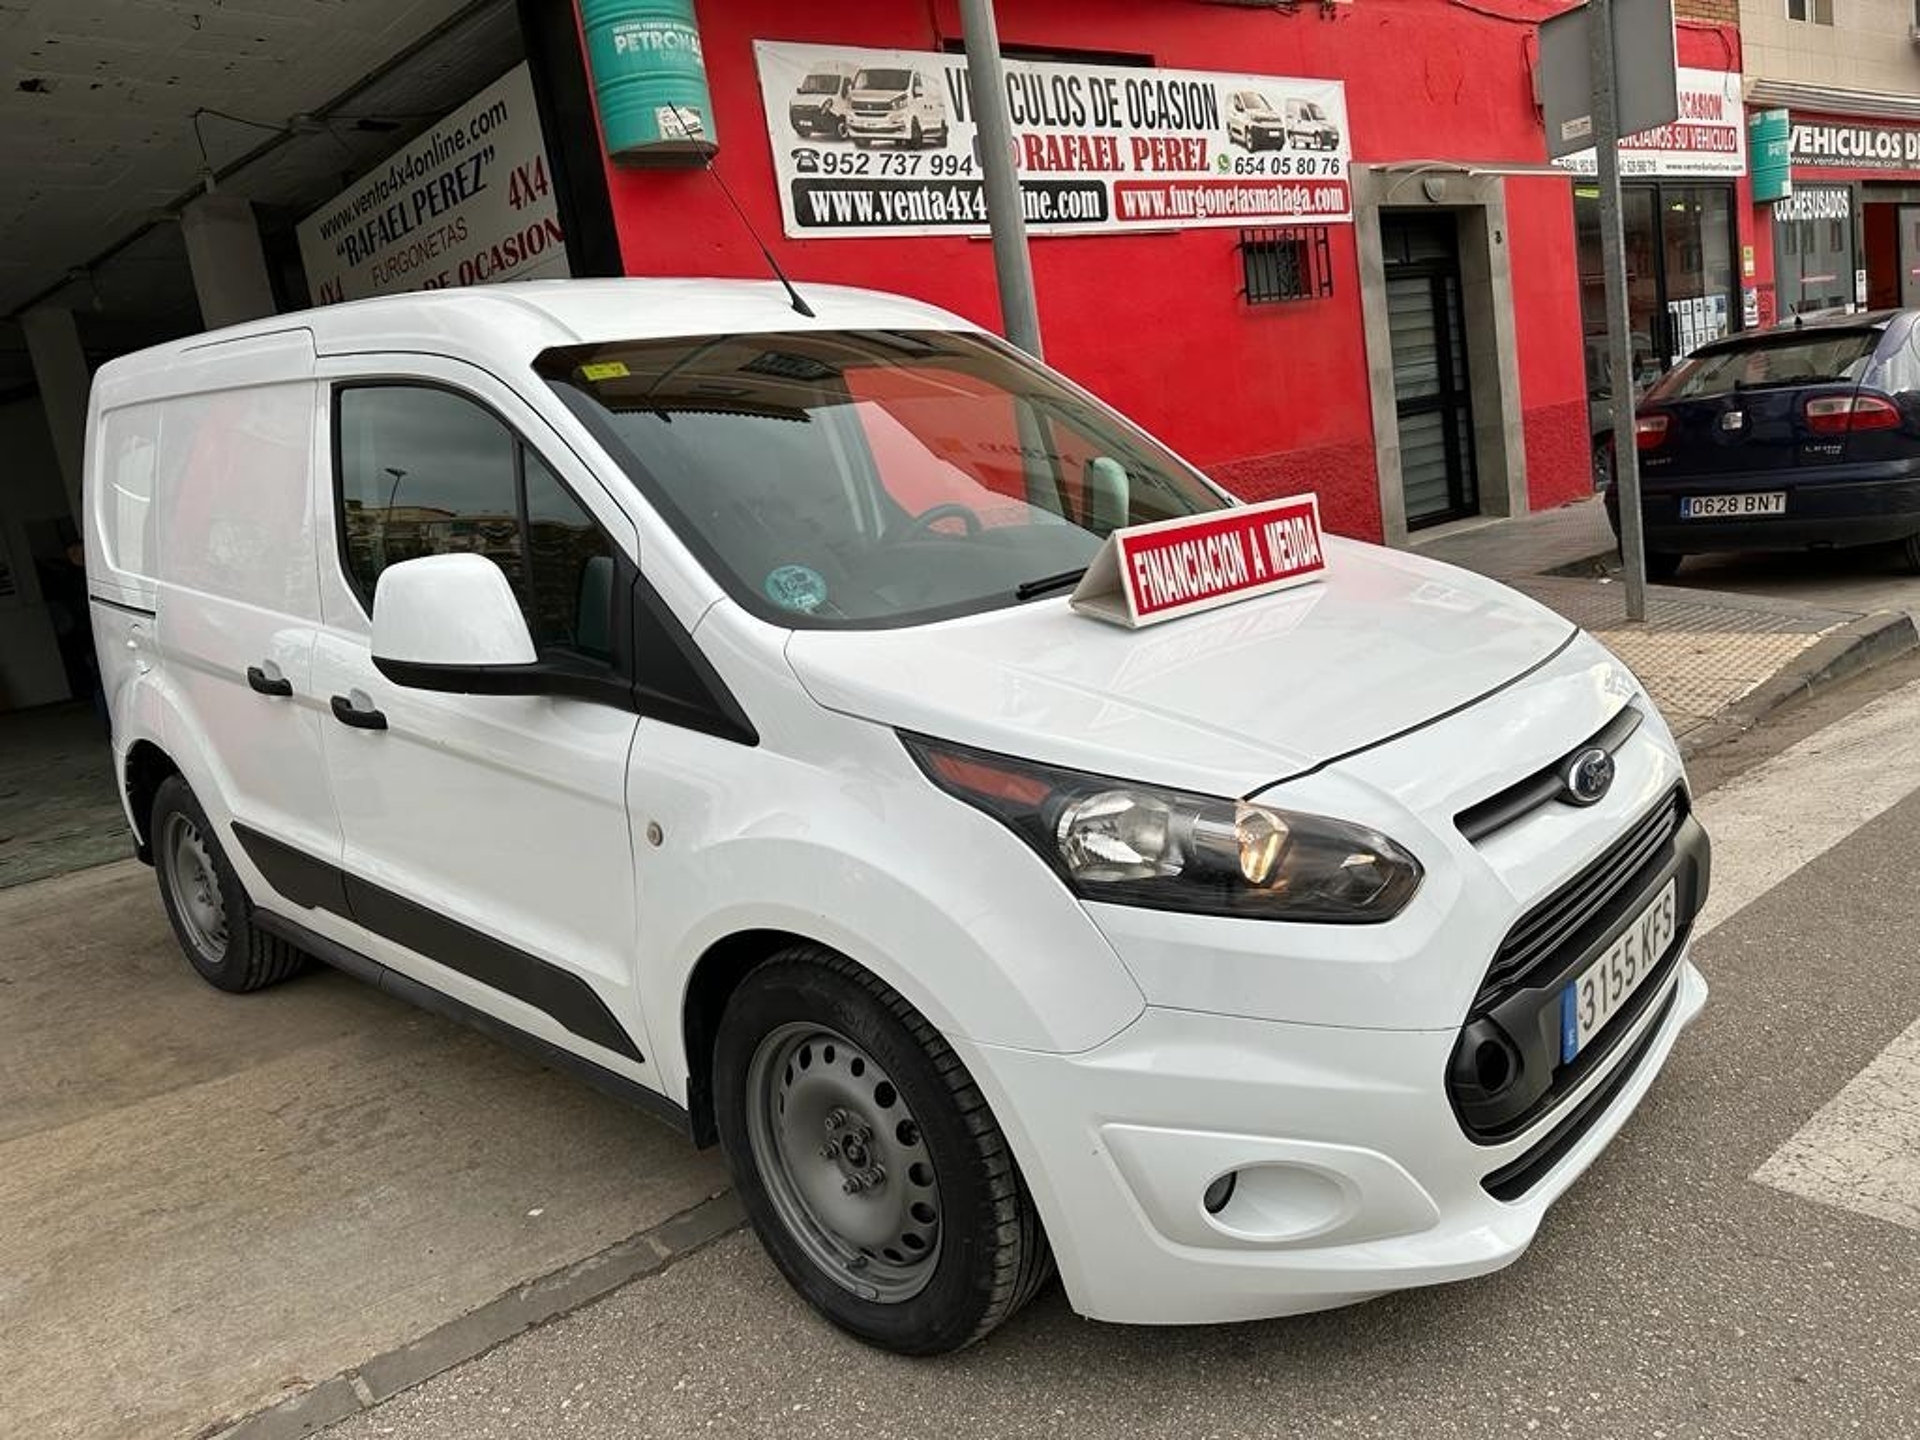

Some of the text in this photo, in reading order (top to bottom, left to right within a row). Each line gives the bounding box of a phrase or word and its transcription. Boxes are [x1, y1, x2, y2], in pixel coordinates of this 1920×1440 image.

[945, 67, 1220, 131] VCULOS DE OCASION
[1022, 132, 1210, 172] RAFAEL PEREZ
[1674, 127, 1688, 149] SU
[1689, 127, 1736, 151] VEHICULO
[1904, 132, 1920, 160] D
[320, 100, 508, 241] www.venta4x4online.com
[508, 155, 548, 211] 4X4
[823, 152, 972, 176] 952 737 994
[1234, 157, 1339, 175] 654 05 80 76
[808, 185, 1101, 222] www.venta4x4ine.com
[1121, 184, 1345, 218] www.furgonetasmalaga.com
[371, 216, 468, 287] FURGONETAS
[458, 217, 566, 287] OCASION
[1692, 494, 1785, 515] 0628 BNT
[1132, 513, 1322, 609] FINANCIACION A MEDIDA
[1581, 893, 1672, 1032] 3155 KFS
